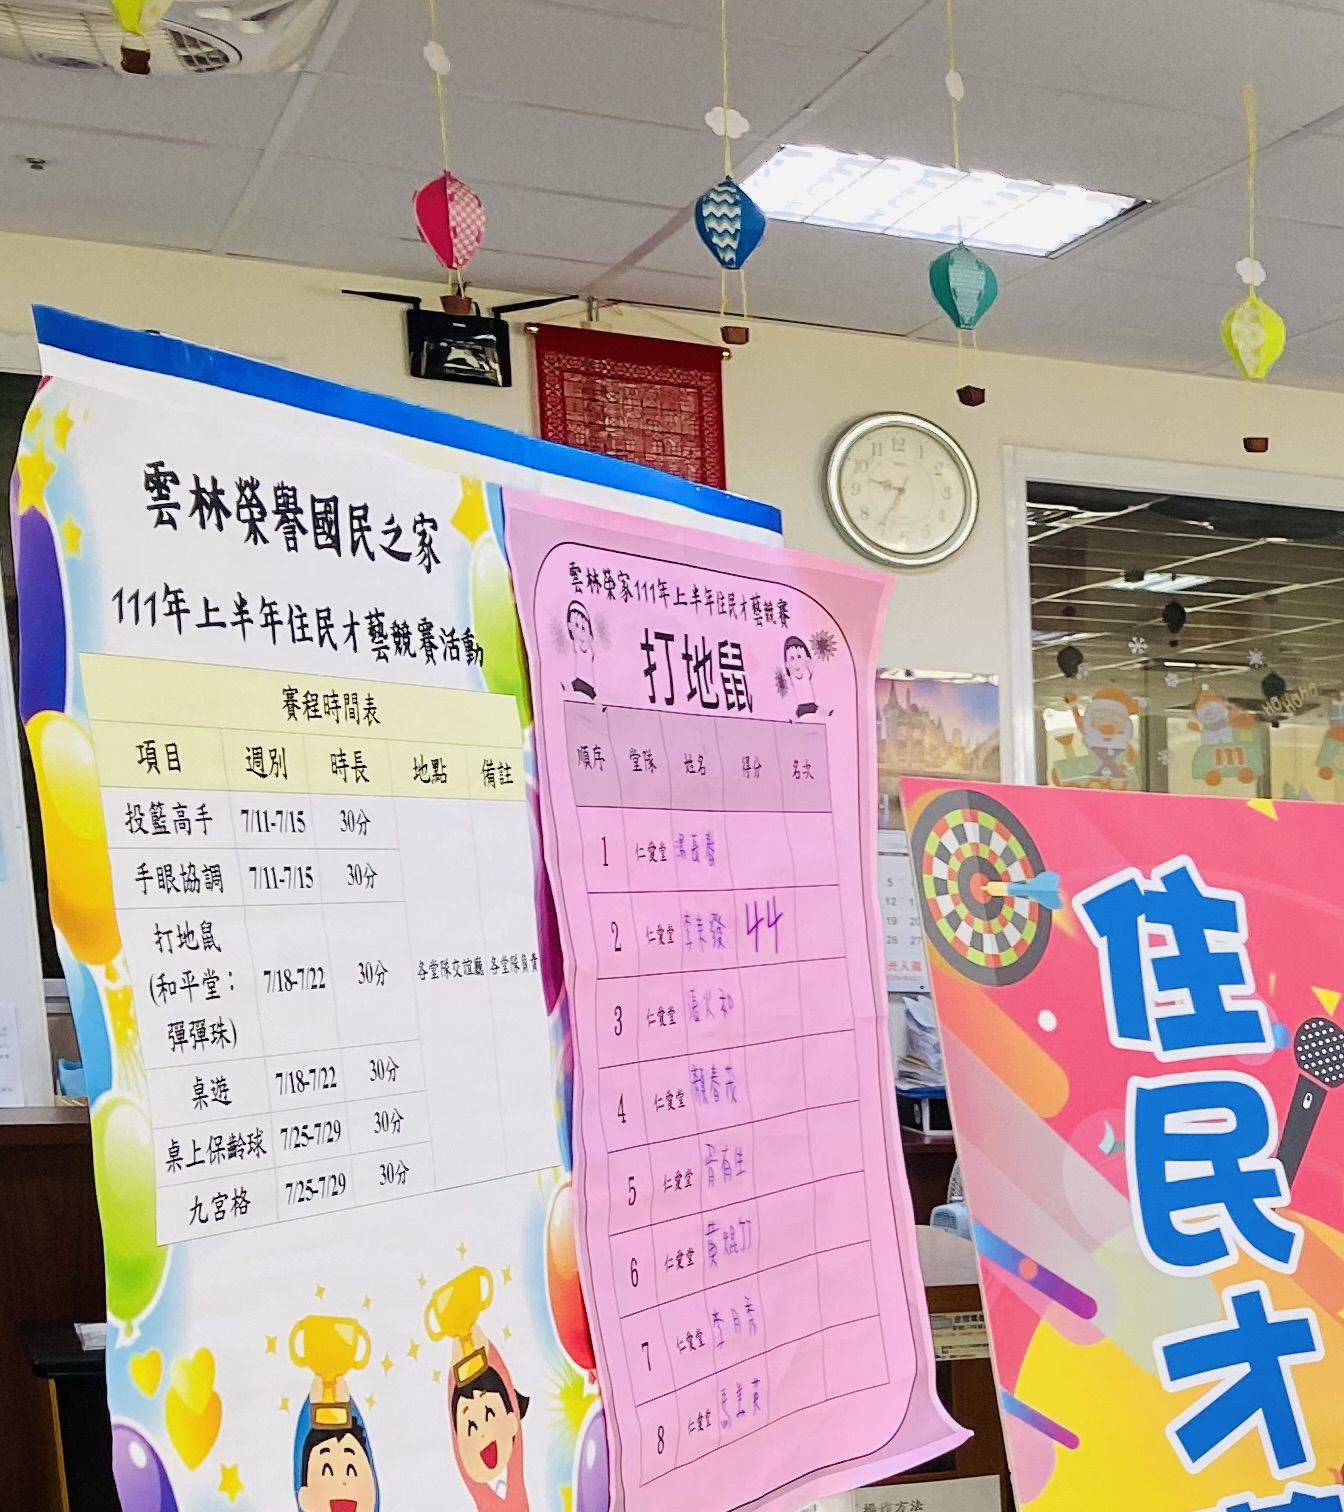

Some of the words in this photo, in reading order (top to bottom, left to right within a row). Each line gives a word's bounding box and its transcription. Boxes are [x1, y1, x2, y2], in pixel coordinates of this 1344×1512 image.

[143, 461, 442, 573] 雲林榮譽國民之家
[112, 583, 484, 667] 111年上半年住民才藝競賽活動
[640, 627, 753, 713] 打地鼠
[282, 685, 381, 726] 賽程時間表
[136, 741, 181, 774] 項目
[246, 745, 287, 779] 週別
[331, 750, 370, 785] 時長
[412, 756, 448, 785] 地點
[482, 758, 515, 789] 備註
[577, 745, 605, 772] 順序
[792, 759, 815, 780] 名次
[125, 802, 213, 838] 投籃高手
[241, 809, 307, 835] 7/11-7/15
[340, 808, 371, 836] 30分
[601, 836, 609, 866] 1
[134, 862, 224, 896] 手眼協調
[249, 866, 313, 891] 7/11-7/15
[347, 865, 378, 890] 30分
[885, 897, 897, 907] 12
[154, 920, 222, 954] 打地鼠
[611, 921, 622, 952] 2
[744, 896, 783, 953] 44
[886, 915, 898, 926] 19
[263, 964, 326, 994] 7/18-7/22
[358, 964, 389, 987] 30分
[168, 1019, 237, 1053] 彈彈珠)
[614, 1005, 622, 1036] 3
[192, 1076, 233, 1110] 桌遊
[275, 1065, 338, 1096] 7/18-7/22
[369, 1055, 400, 1083] 30分
[617, 1093, 627, 1125] 4
[166, 1128, 267, 1173] 桌上保齡球
[280, 1119, 342, 1150] 7/25-7/29
[374, 1107, 404, 1134] 30分
[189, 1188, 251, 1226] 九宮格
[285, 1171, 347, 1204] 7/25-7/29
[379, 1159, 410, 1187] 30分
[628, 1175, 637, 1206] 5
[630, 1257, 639, 1288] 6
[641, 1341, 651, 1371] 7
[657, 1425, 665, 1454] 8
